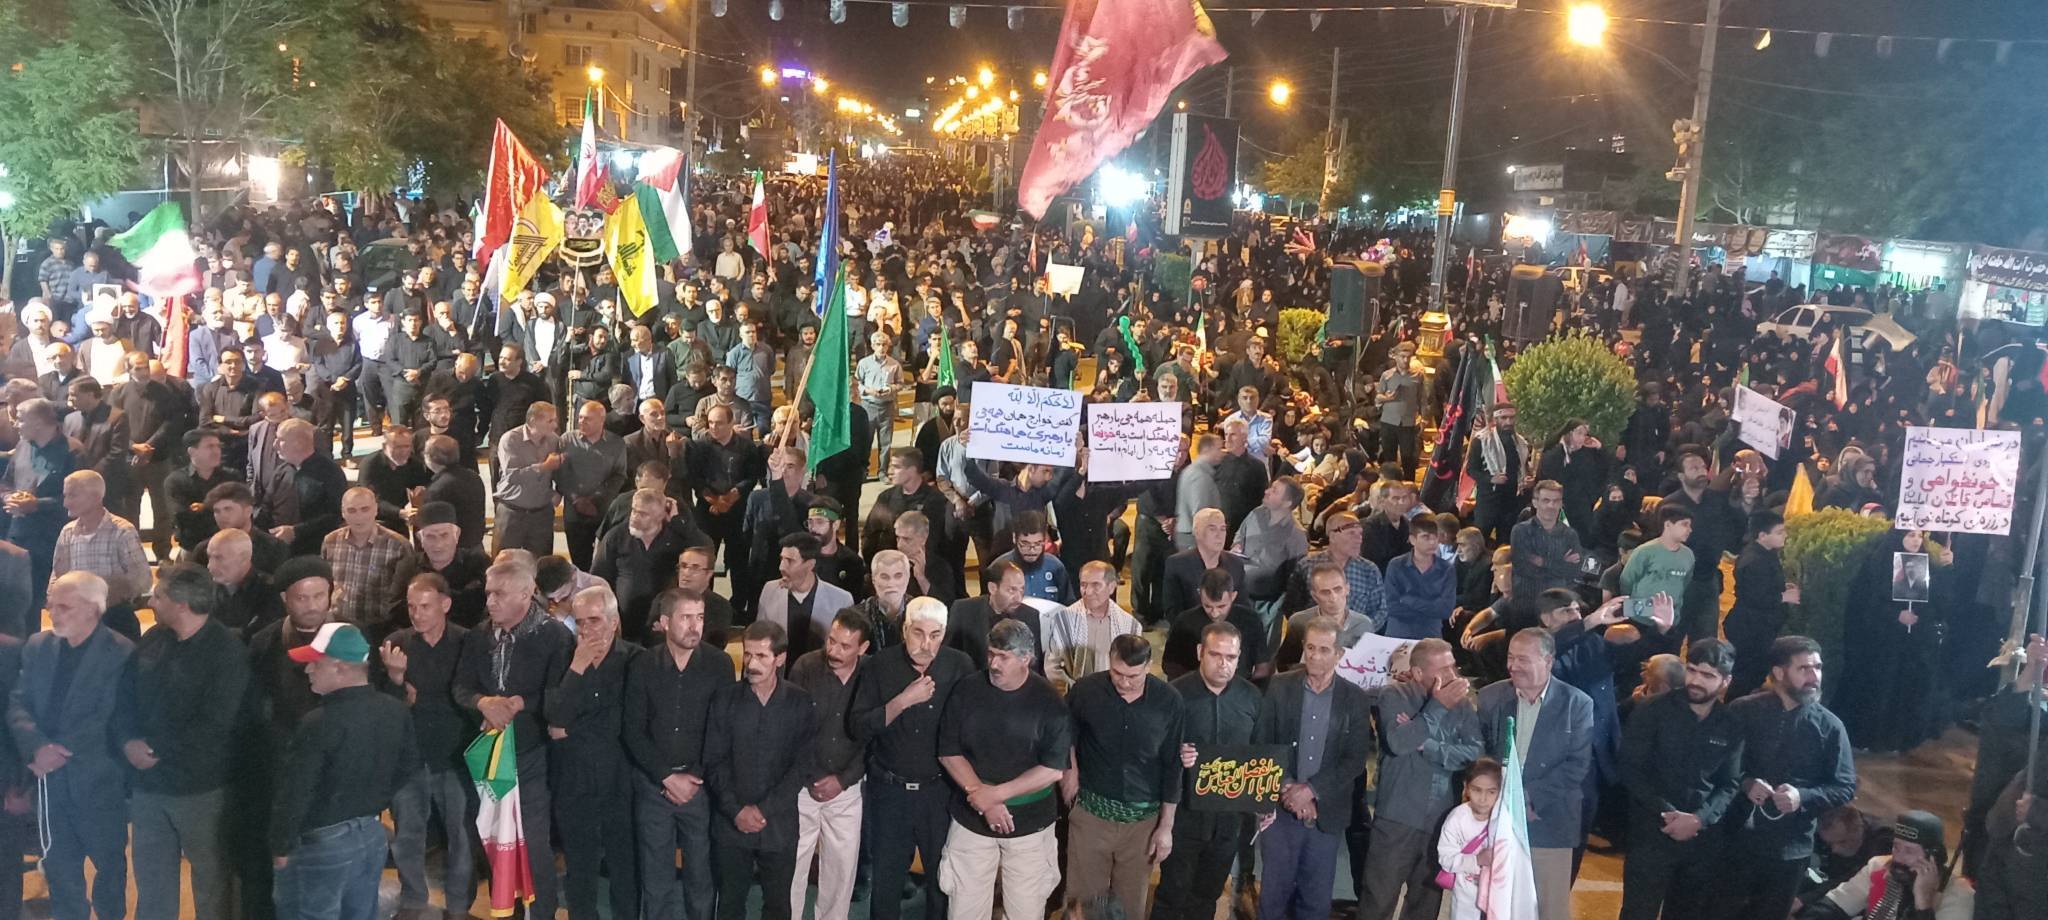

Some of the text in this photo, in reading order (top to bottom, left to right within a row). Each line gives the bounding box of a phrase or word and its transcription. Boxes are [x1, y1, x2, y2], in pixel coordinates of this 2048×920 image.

[1003, 409, 1027, 421] همان
[1134, 410, 1152, 424] همه
[1128, 428, 1146, 440] است
[1039, 446, 1065, 458] زمانه
